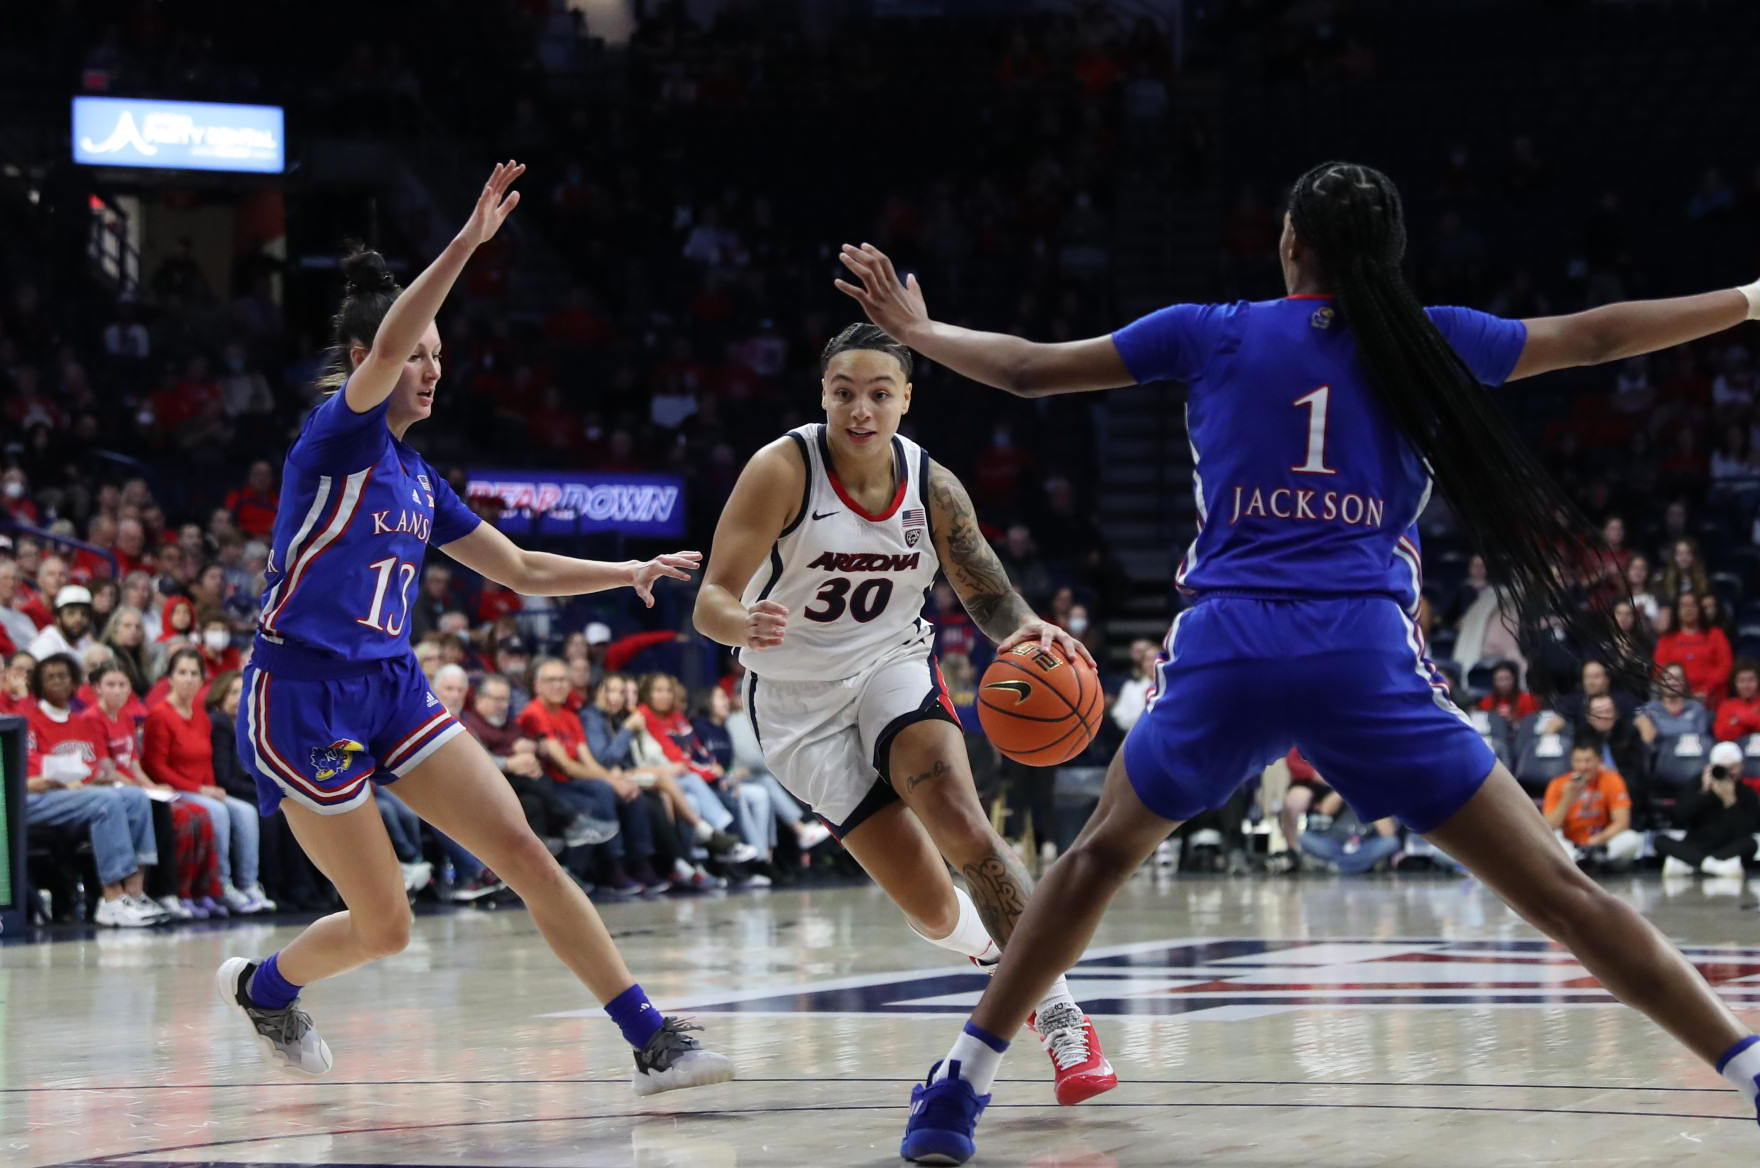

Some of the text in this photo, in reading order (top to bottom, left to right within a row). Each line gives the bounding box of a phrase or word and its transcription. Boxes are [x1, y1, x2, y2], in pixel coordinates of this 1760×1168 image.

[1290, 383, 1337, 475] 1
[558, 484, 679, 522] DOWN
[1229, 486, 1384, 529] JACKSON
[371, 509, 431, 544] KANS
[806, 551, 921, 573] ARIZONA
[355, 556, 416, 637] 13
[804, 577, 894, 623] 30
